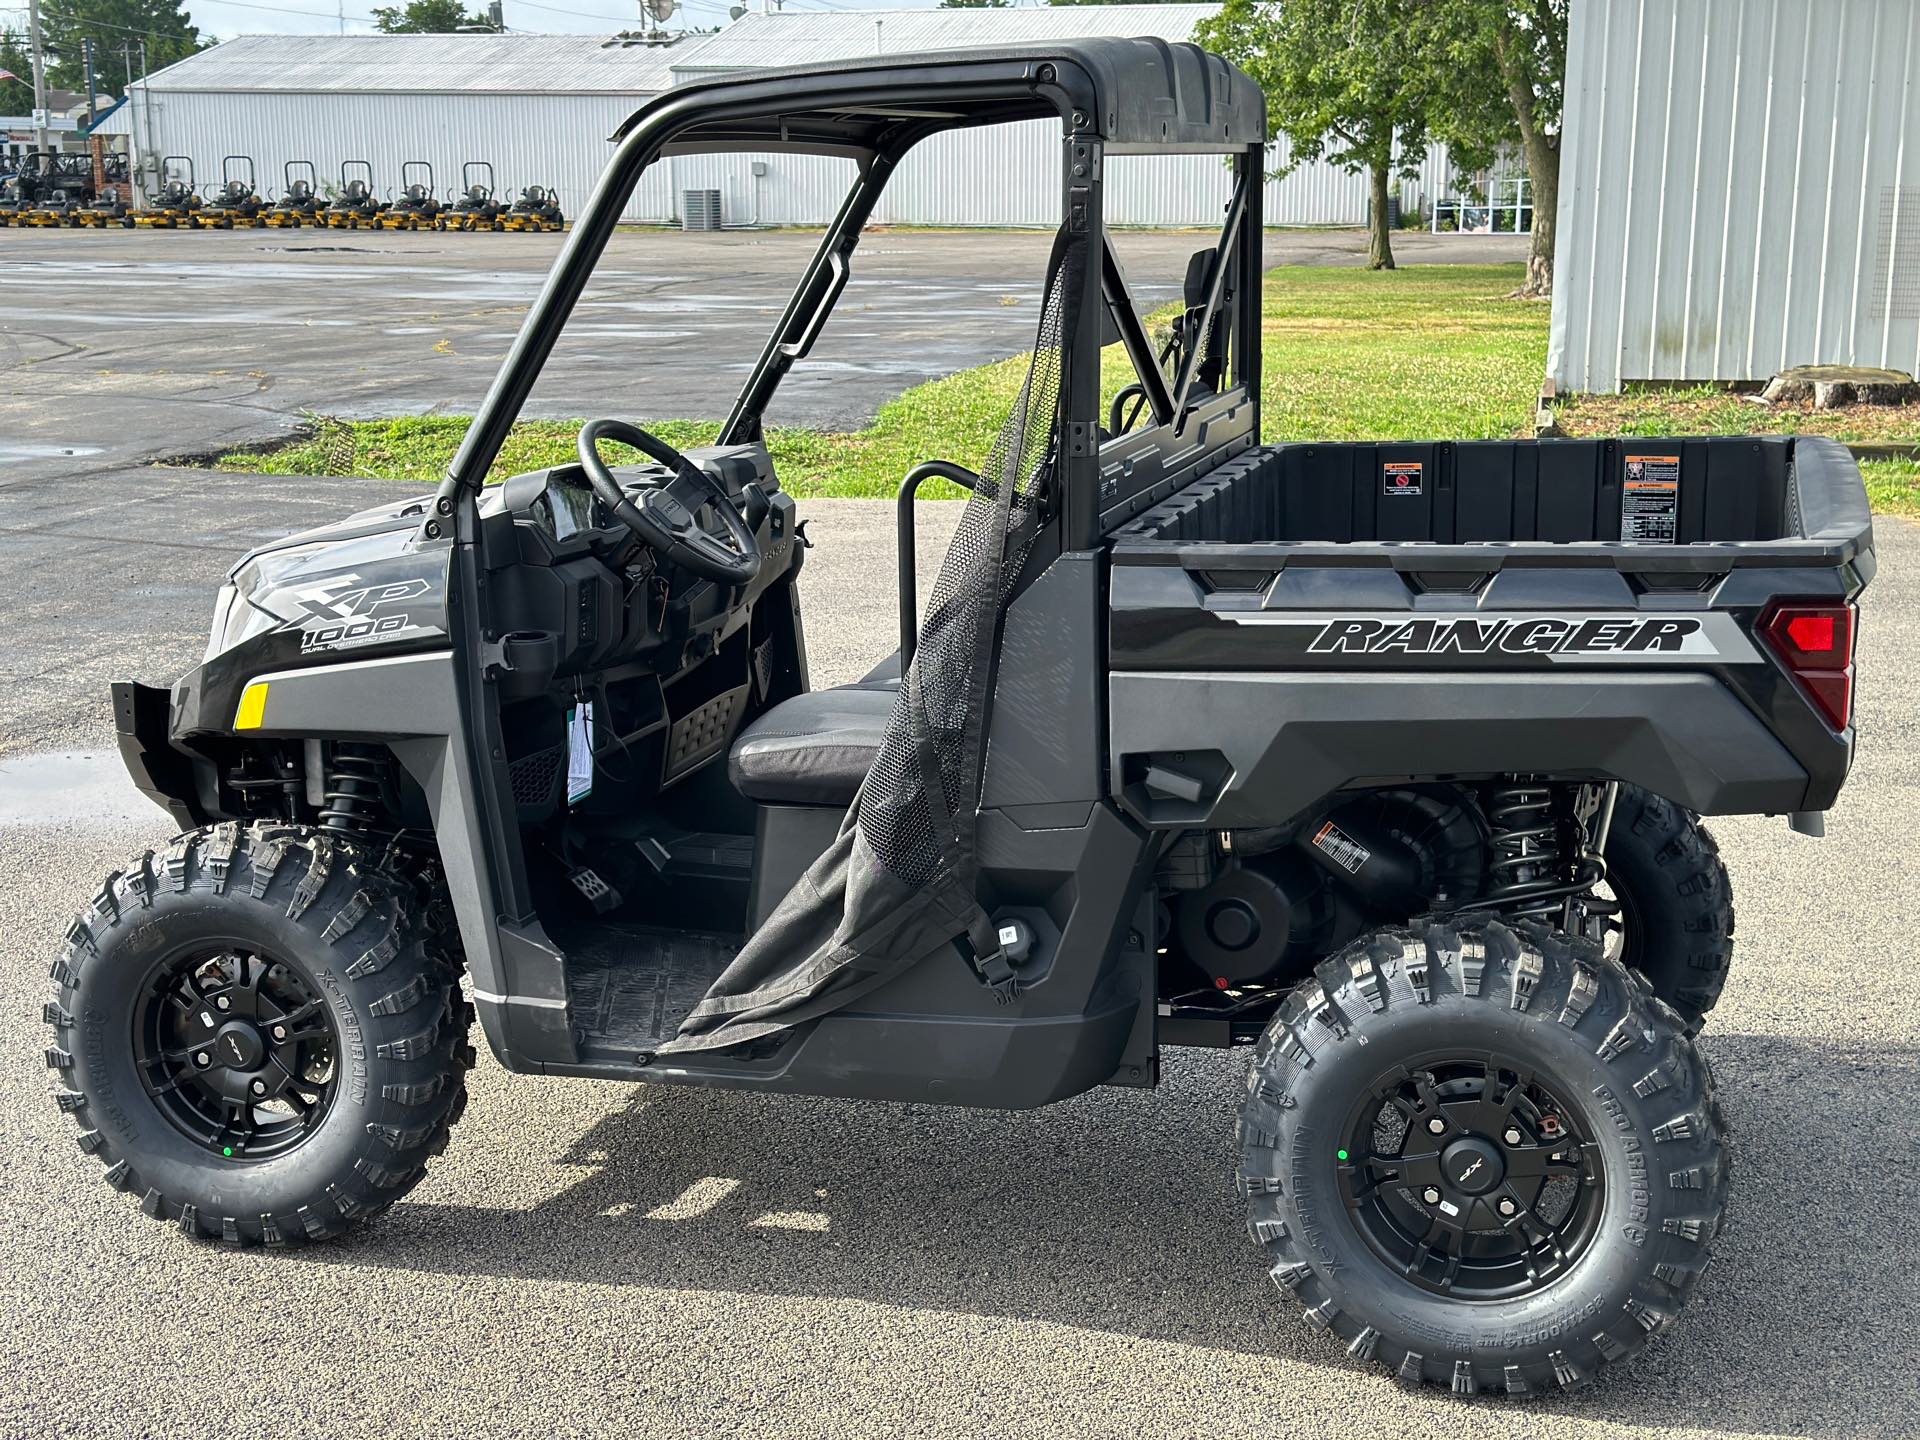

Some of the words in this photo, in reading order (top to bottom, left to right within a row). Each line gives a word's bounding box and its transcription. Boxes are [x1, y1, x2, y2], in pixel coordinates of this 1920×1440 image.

[270, 578, 431, 634] XP
[301, 613, 408, 648] 1000
[301, 645, 326, 655] DUAL
[327, 637, 378, 651] OVERHEAD
[379, 632, 401, 643] CAM
[1306, 618, 1702, 654] RANGER
[315, 967, 367, 1106] X-TERRAIN
[1459, 1158, 1482, 1181] XP
[1591, 1084, 1631, 1132] PRO
[1619, 1136, 1650, 1223] ARMOR
